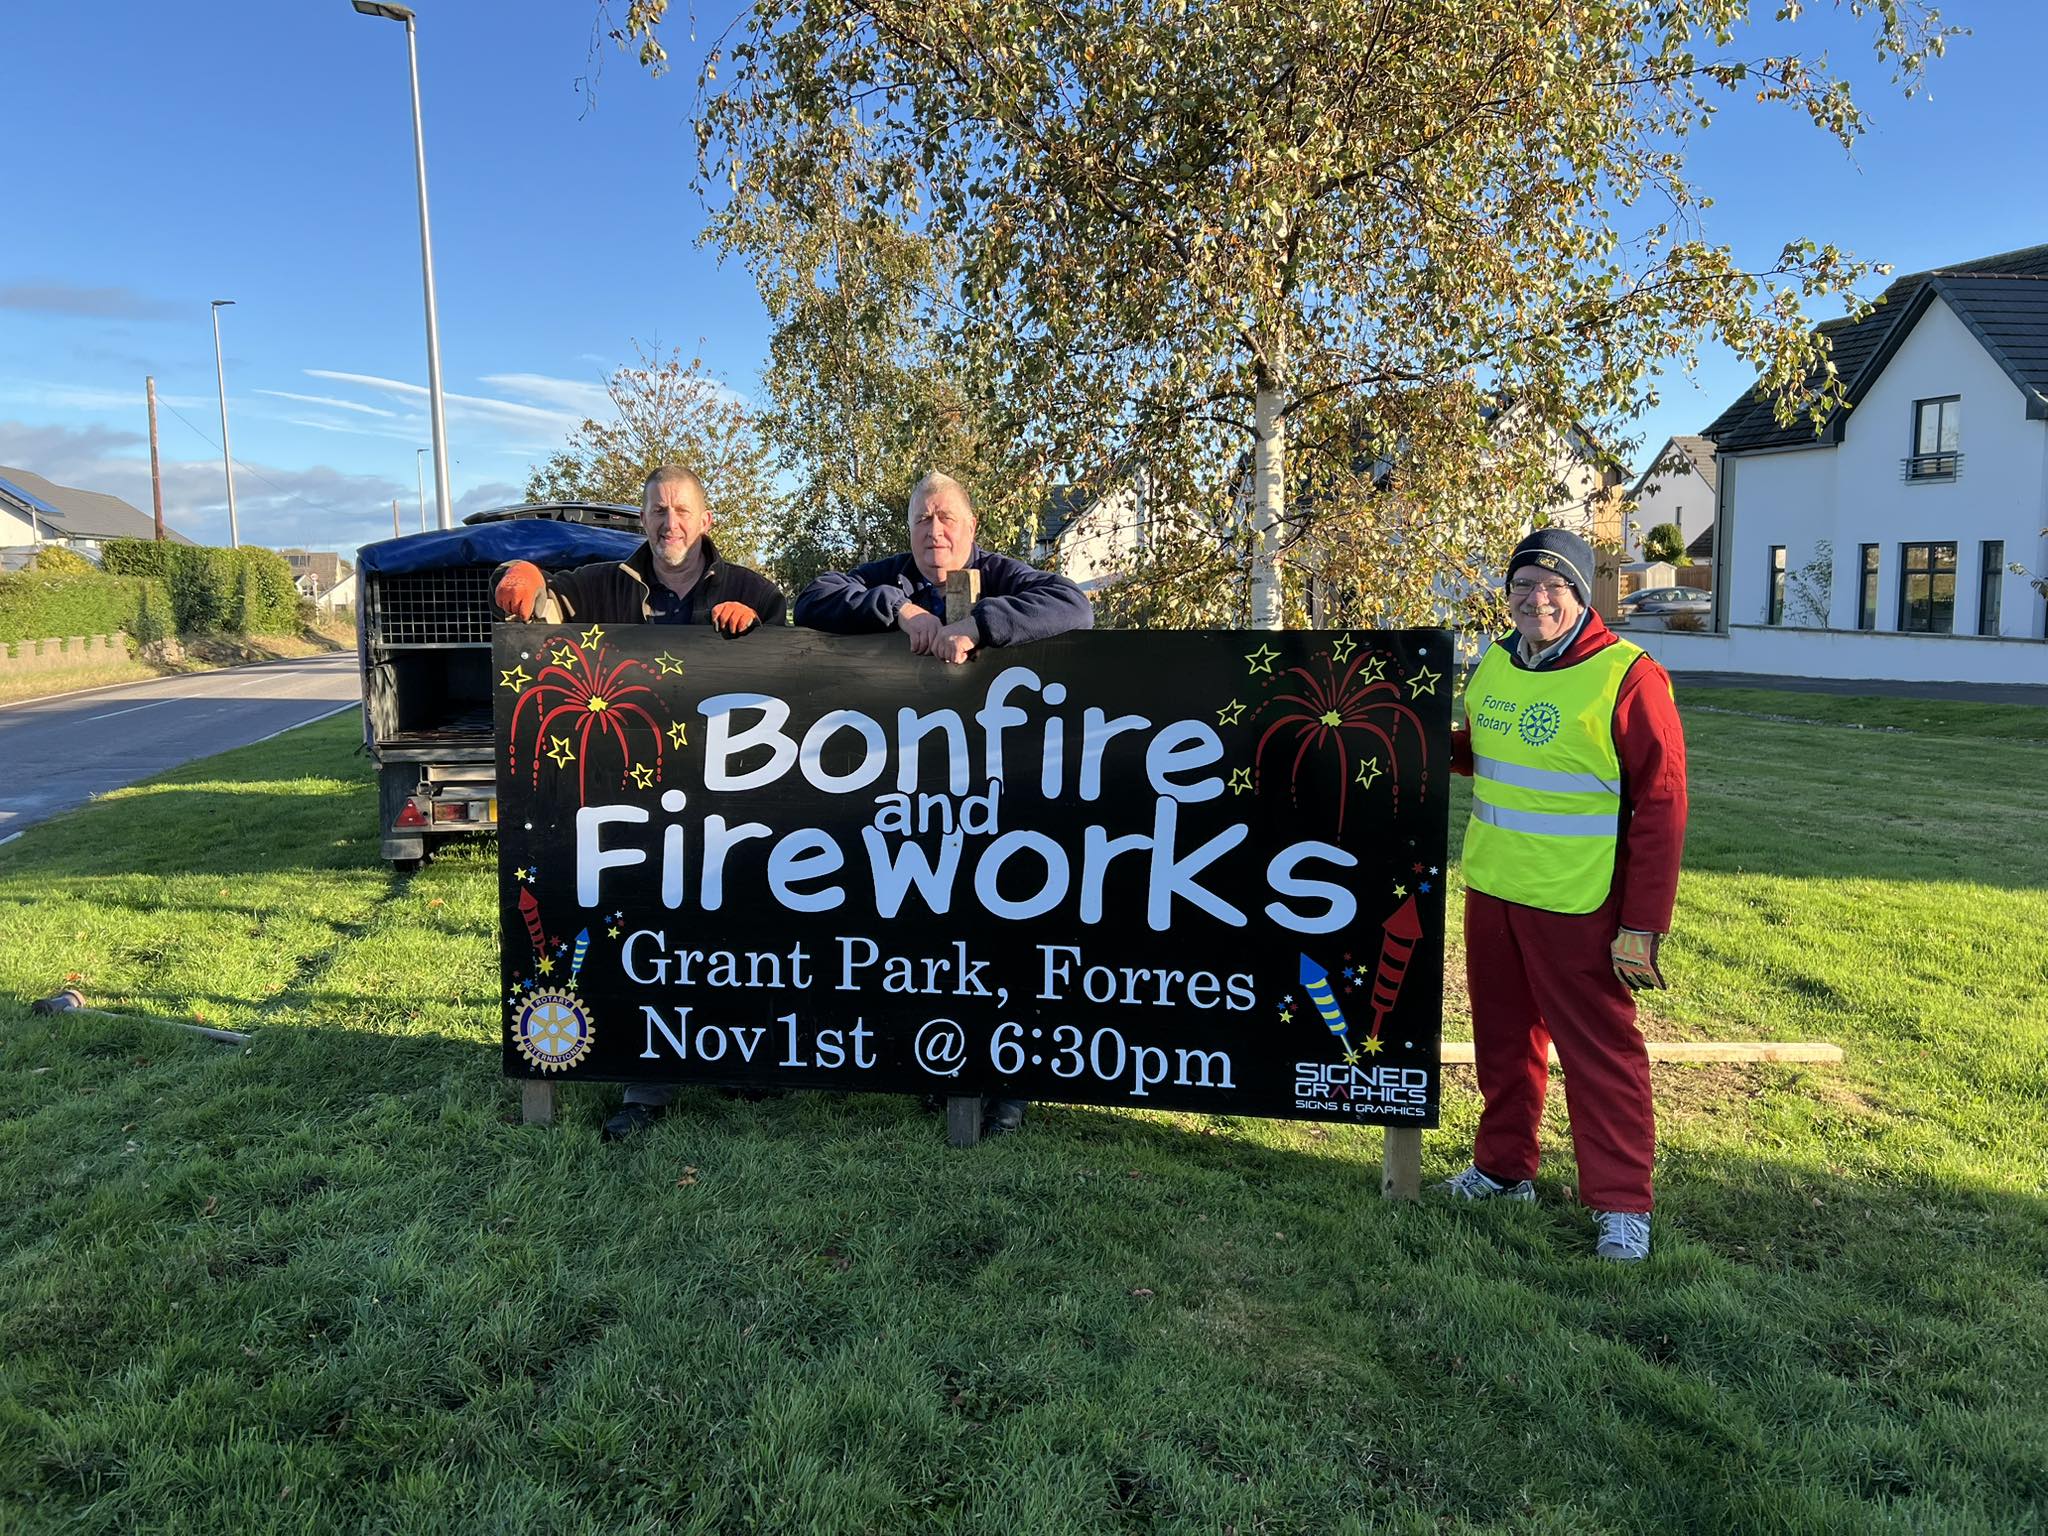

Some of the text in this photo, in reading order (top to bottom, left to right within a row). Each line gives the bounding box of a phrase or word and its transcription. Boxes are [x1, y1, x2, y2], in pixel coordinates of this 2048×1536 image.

[1482, 695, 1517, 713] Forres
[697, 666, 1225, 803] Bonfire
[1476, 713, 1513, 736] Rotary
[874, 777, 1000, 836] and
[576, 789, 1359, 935] Fireworks
[621, 930, 1257, 1011] Grant Park, Forres
[535, 995, 570, 1006] ROTARY
[525, 1041, 584, 1063] INTERNATIONAL
[914, 1018, 967, 1077] @
[990, 1021, 1238, 1097] 6:30pm
[1295, 1062, 1428, 1089] SIGNED
[1295, 1082, 1427, 1104] GRAPHICS
[1295, 1099, 1426, 1117] SIGNS & GRAPHICS
